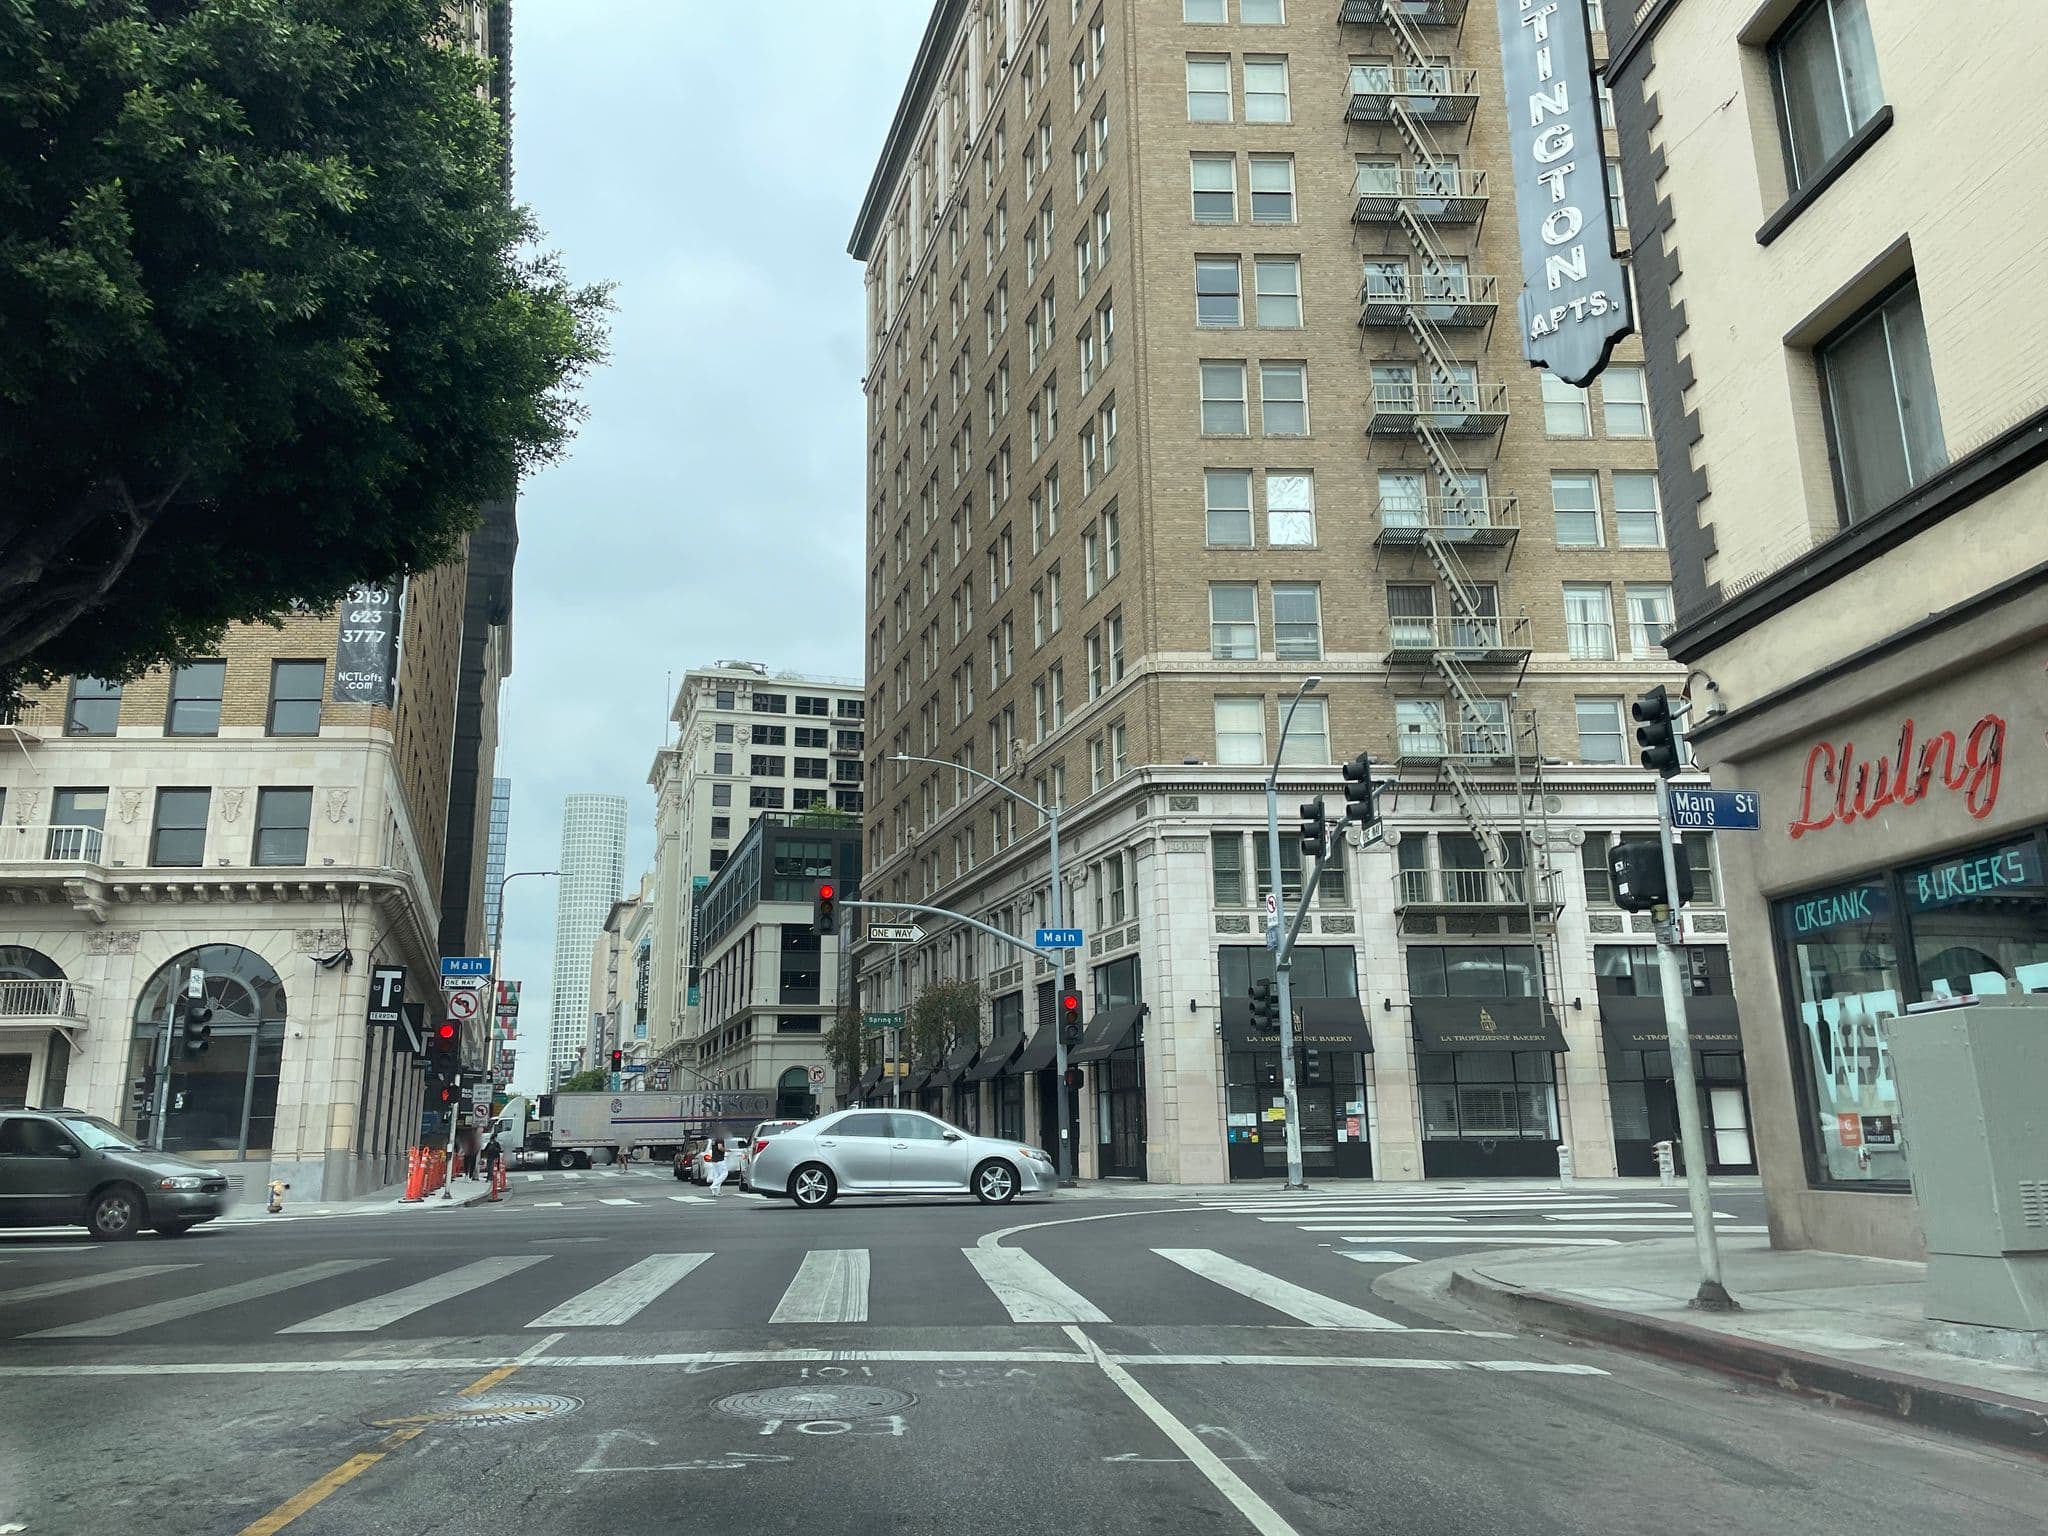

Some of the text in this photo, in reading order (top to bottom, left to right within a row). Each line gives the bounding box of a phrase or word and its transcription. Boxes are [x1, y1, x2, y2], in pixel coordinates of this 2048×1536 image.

[1520, 0, 1588, 290] TINGTON
[1530, 290, 1619, 340] APTS.
[350, 611, 382, 623] 623
[342, 630, 386, 643] 3777
[338, 671, 382, 682] NCTLofts
[1675, 792, 1755, 813] Main St
[1678, 812, 1715, 826] 700 S
[1917, 851, 2025, 904] BURGERS
[871, 929, 912, 938] ONE WAY
[1043, 932, 1076, 942] Main
[450, 960, 483, 970] Main
[869, 1016, 891, 1024] Spring
